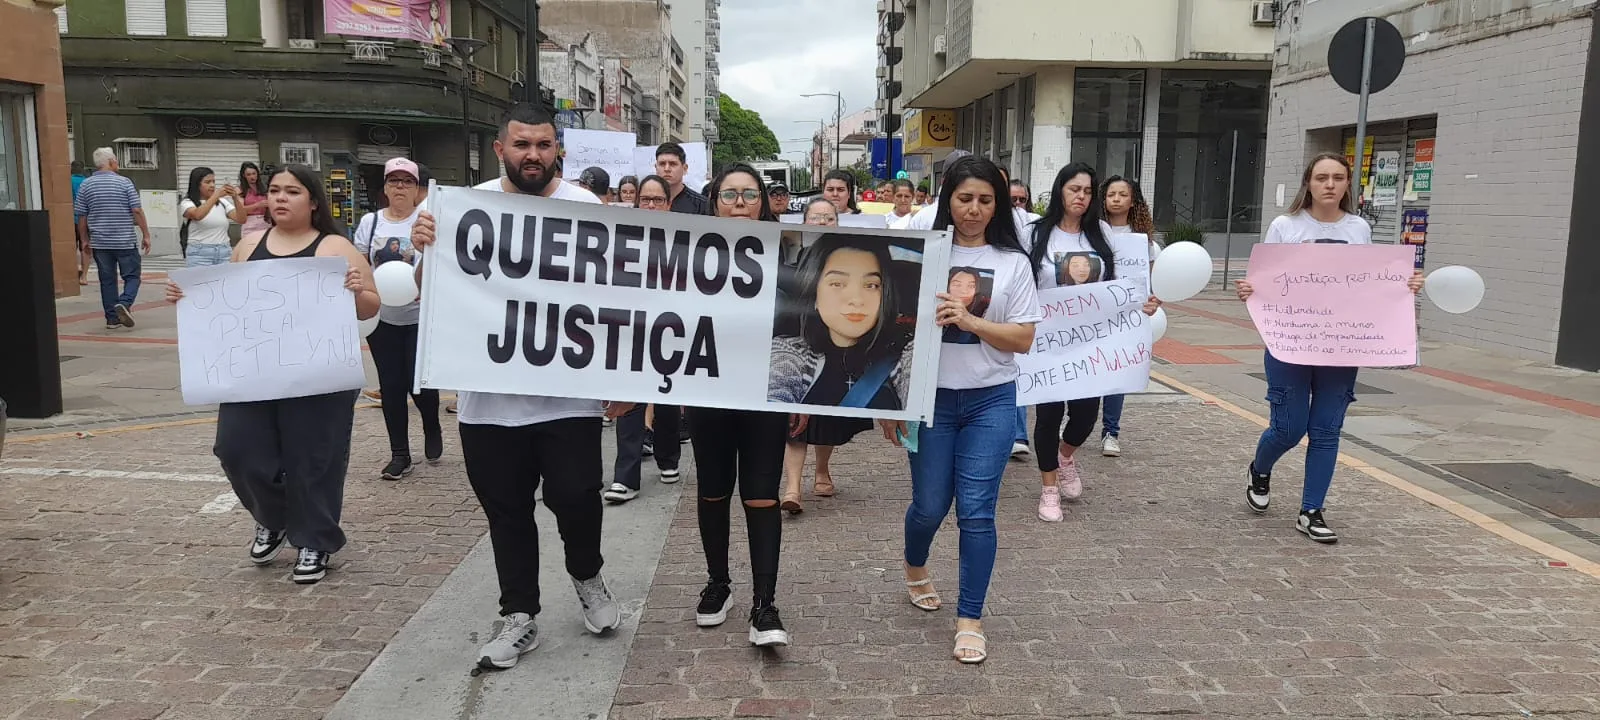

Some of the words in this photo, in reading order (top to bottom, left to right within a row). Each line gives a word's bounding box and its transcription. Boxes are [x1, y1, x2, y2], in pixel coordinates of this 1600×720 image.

[455, 208, 765, 299] QUEREMOS
[192, 269, 346, 312] JUSTIÇ
[1040, 292, 1100, 319] OMEM
[1106, 284, 1140, 307] DE
[1273, 272, 1341, 297] Justiça
[1346, 272, 1371, 288] por
[208, 311, 294, 342] PELA
[1028, 321, 1107, 355] ERDADE
[1107, 309, 1142, 335] NÃO
[1335, 320, 1376, 330] menos
[486, 299, 720, 394] JUSTIÇA
[1062, 359, 1089, 382] EM
